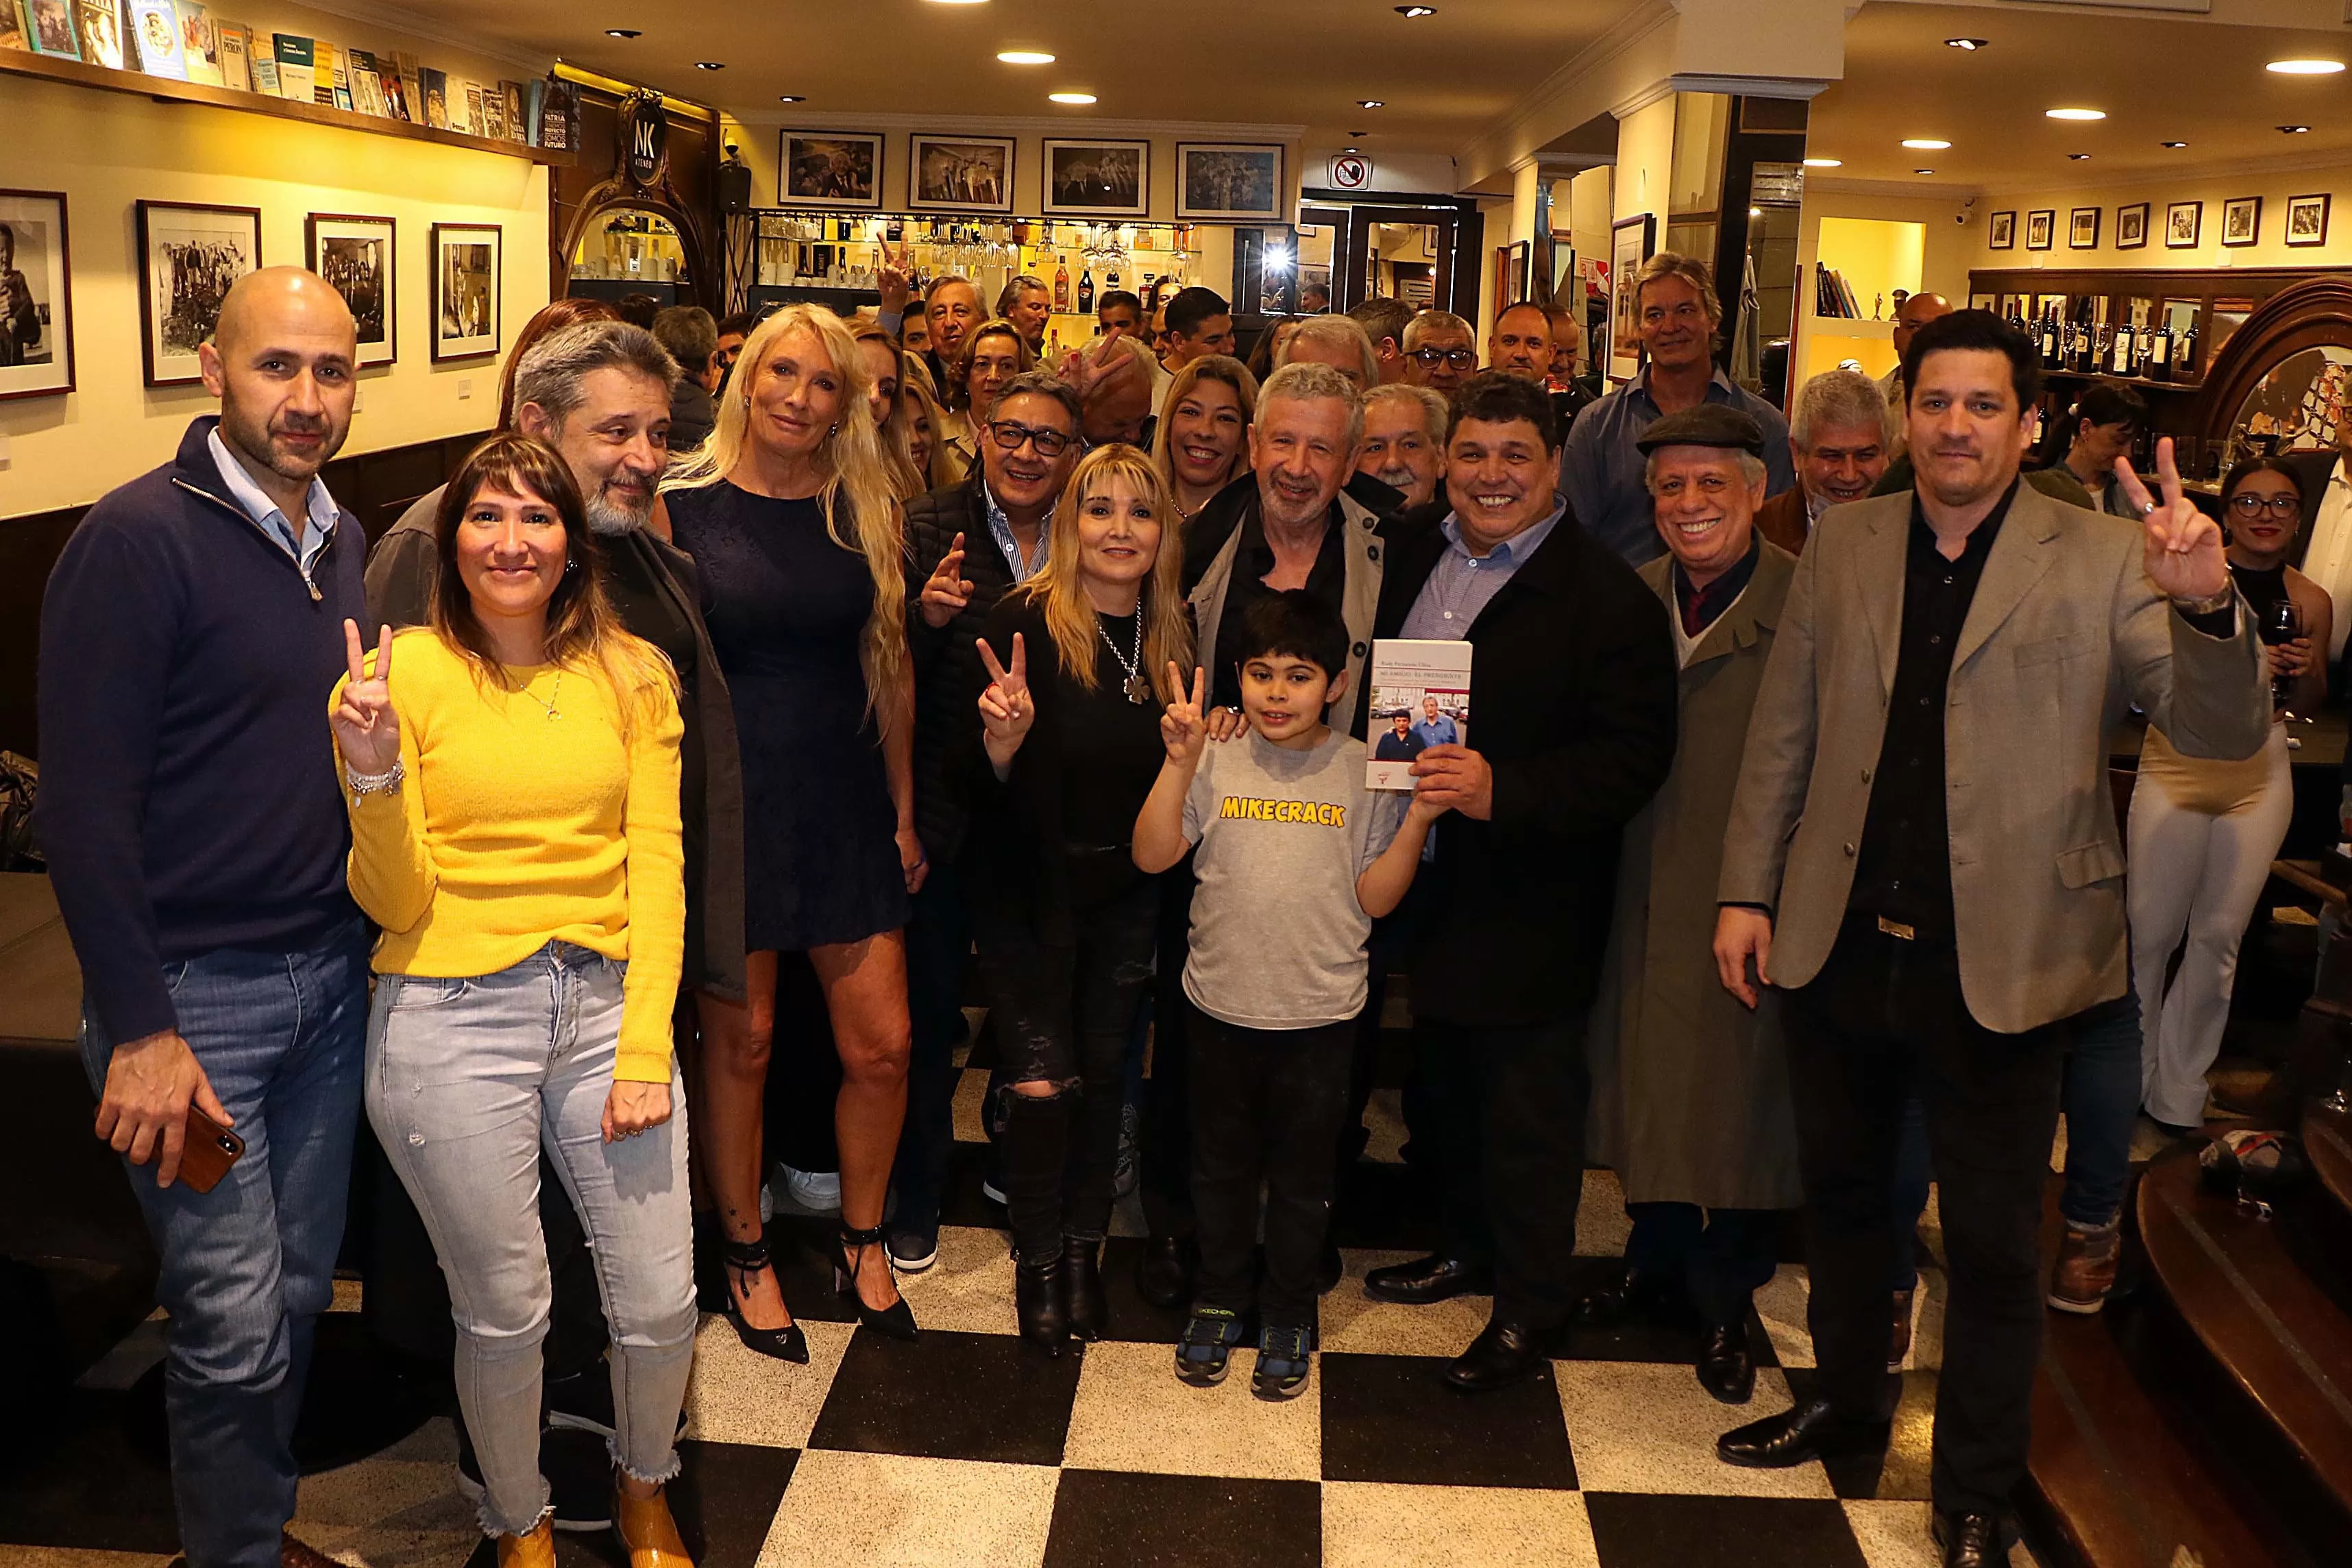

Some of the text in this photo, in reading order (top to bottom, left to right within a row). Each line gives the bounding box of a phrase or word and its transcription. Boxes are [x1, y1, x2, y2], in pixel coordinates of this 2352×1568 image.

[635, 119, 655, 159] NK
[635, 158, 652, 169] ATENEO
[1220, 796, 1346, 828] MIKECRACK
